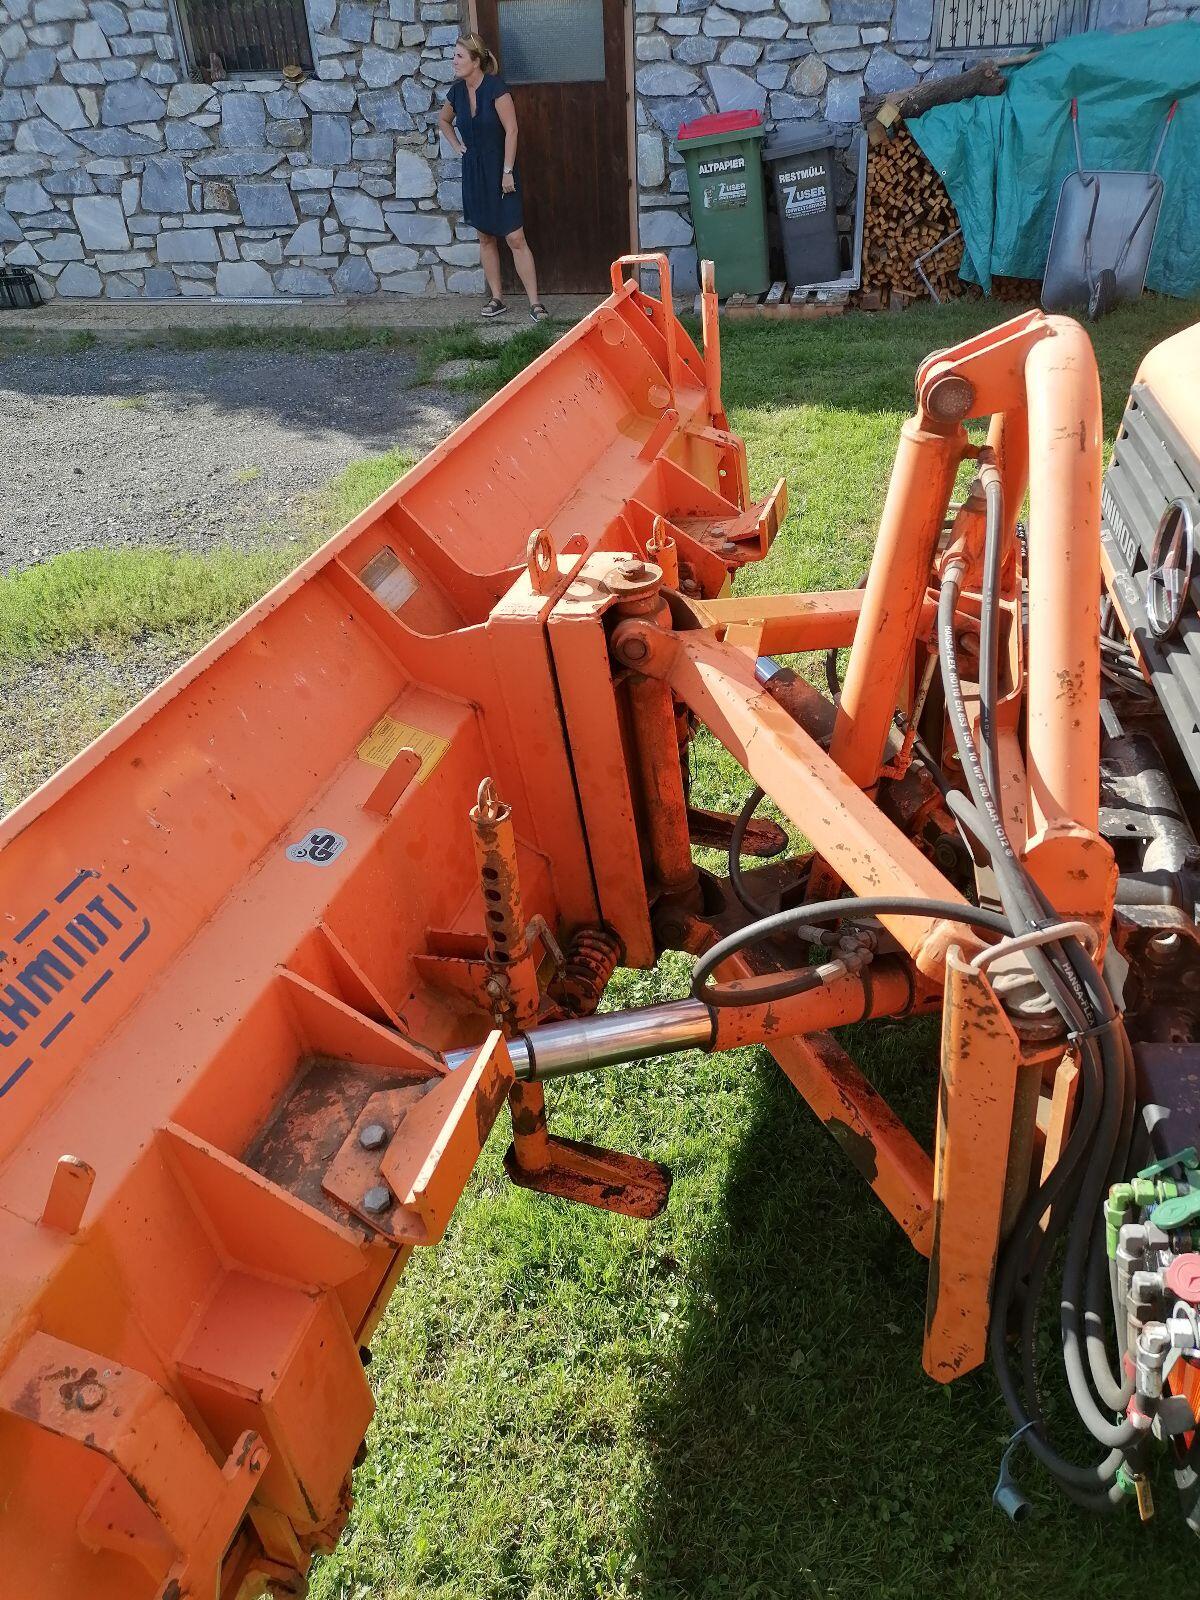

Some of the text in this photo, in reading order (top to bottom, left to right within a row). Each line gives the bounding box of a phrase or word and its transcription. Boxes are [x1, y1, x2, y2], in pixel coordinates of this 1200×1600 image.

[698, 157, 745, 175] ALTPAPIER
[778, 166, 826, 184] RESTMÜLL
[718, 182, 746, 198] ZUSER
[782, 186, 827, 210] ZUSER
[1101, 482, 1136, 567] UNIMOG
[944, 625, 957, 669] HANSA-FLEX
[949, 672, 961, 697] HD110
[955, 700, 965, 713] EN
[957, 712, 969, 727] 853
[963, 730, 975, 748] 1SN
[968, 752, 978, 762] 10
[972, 764, 984, 780] WP
[985, 801, 999, 822] BAR
[994, 823, 1010, 848] 1Q12
[1062, 962, 1096, 1026] HANSA-FLEX
